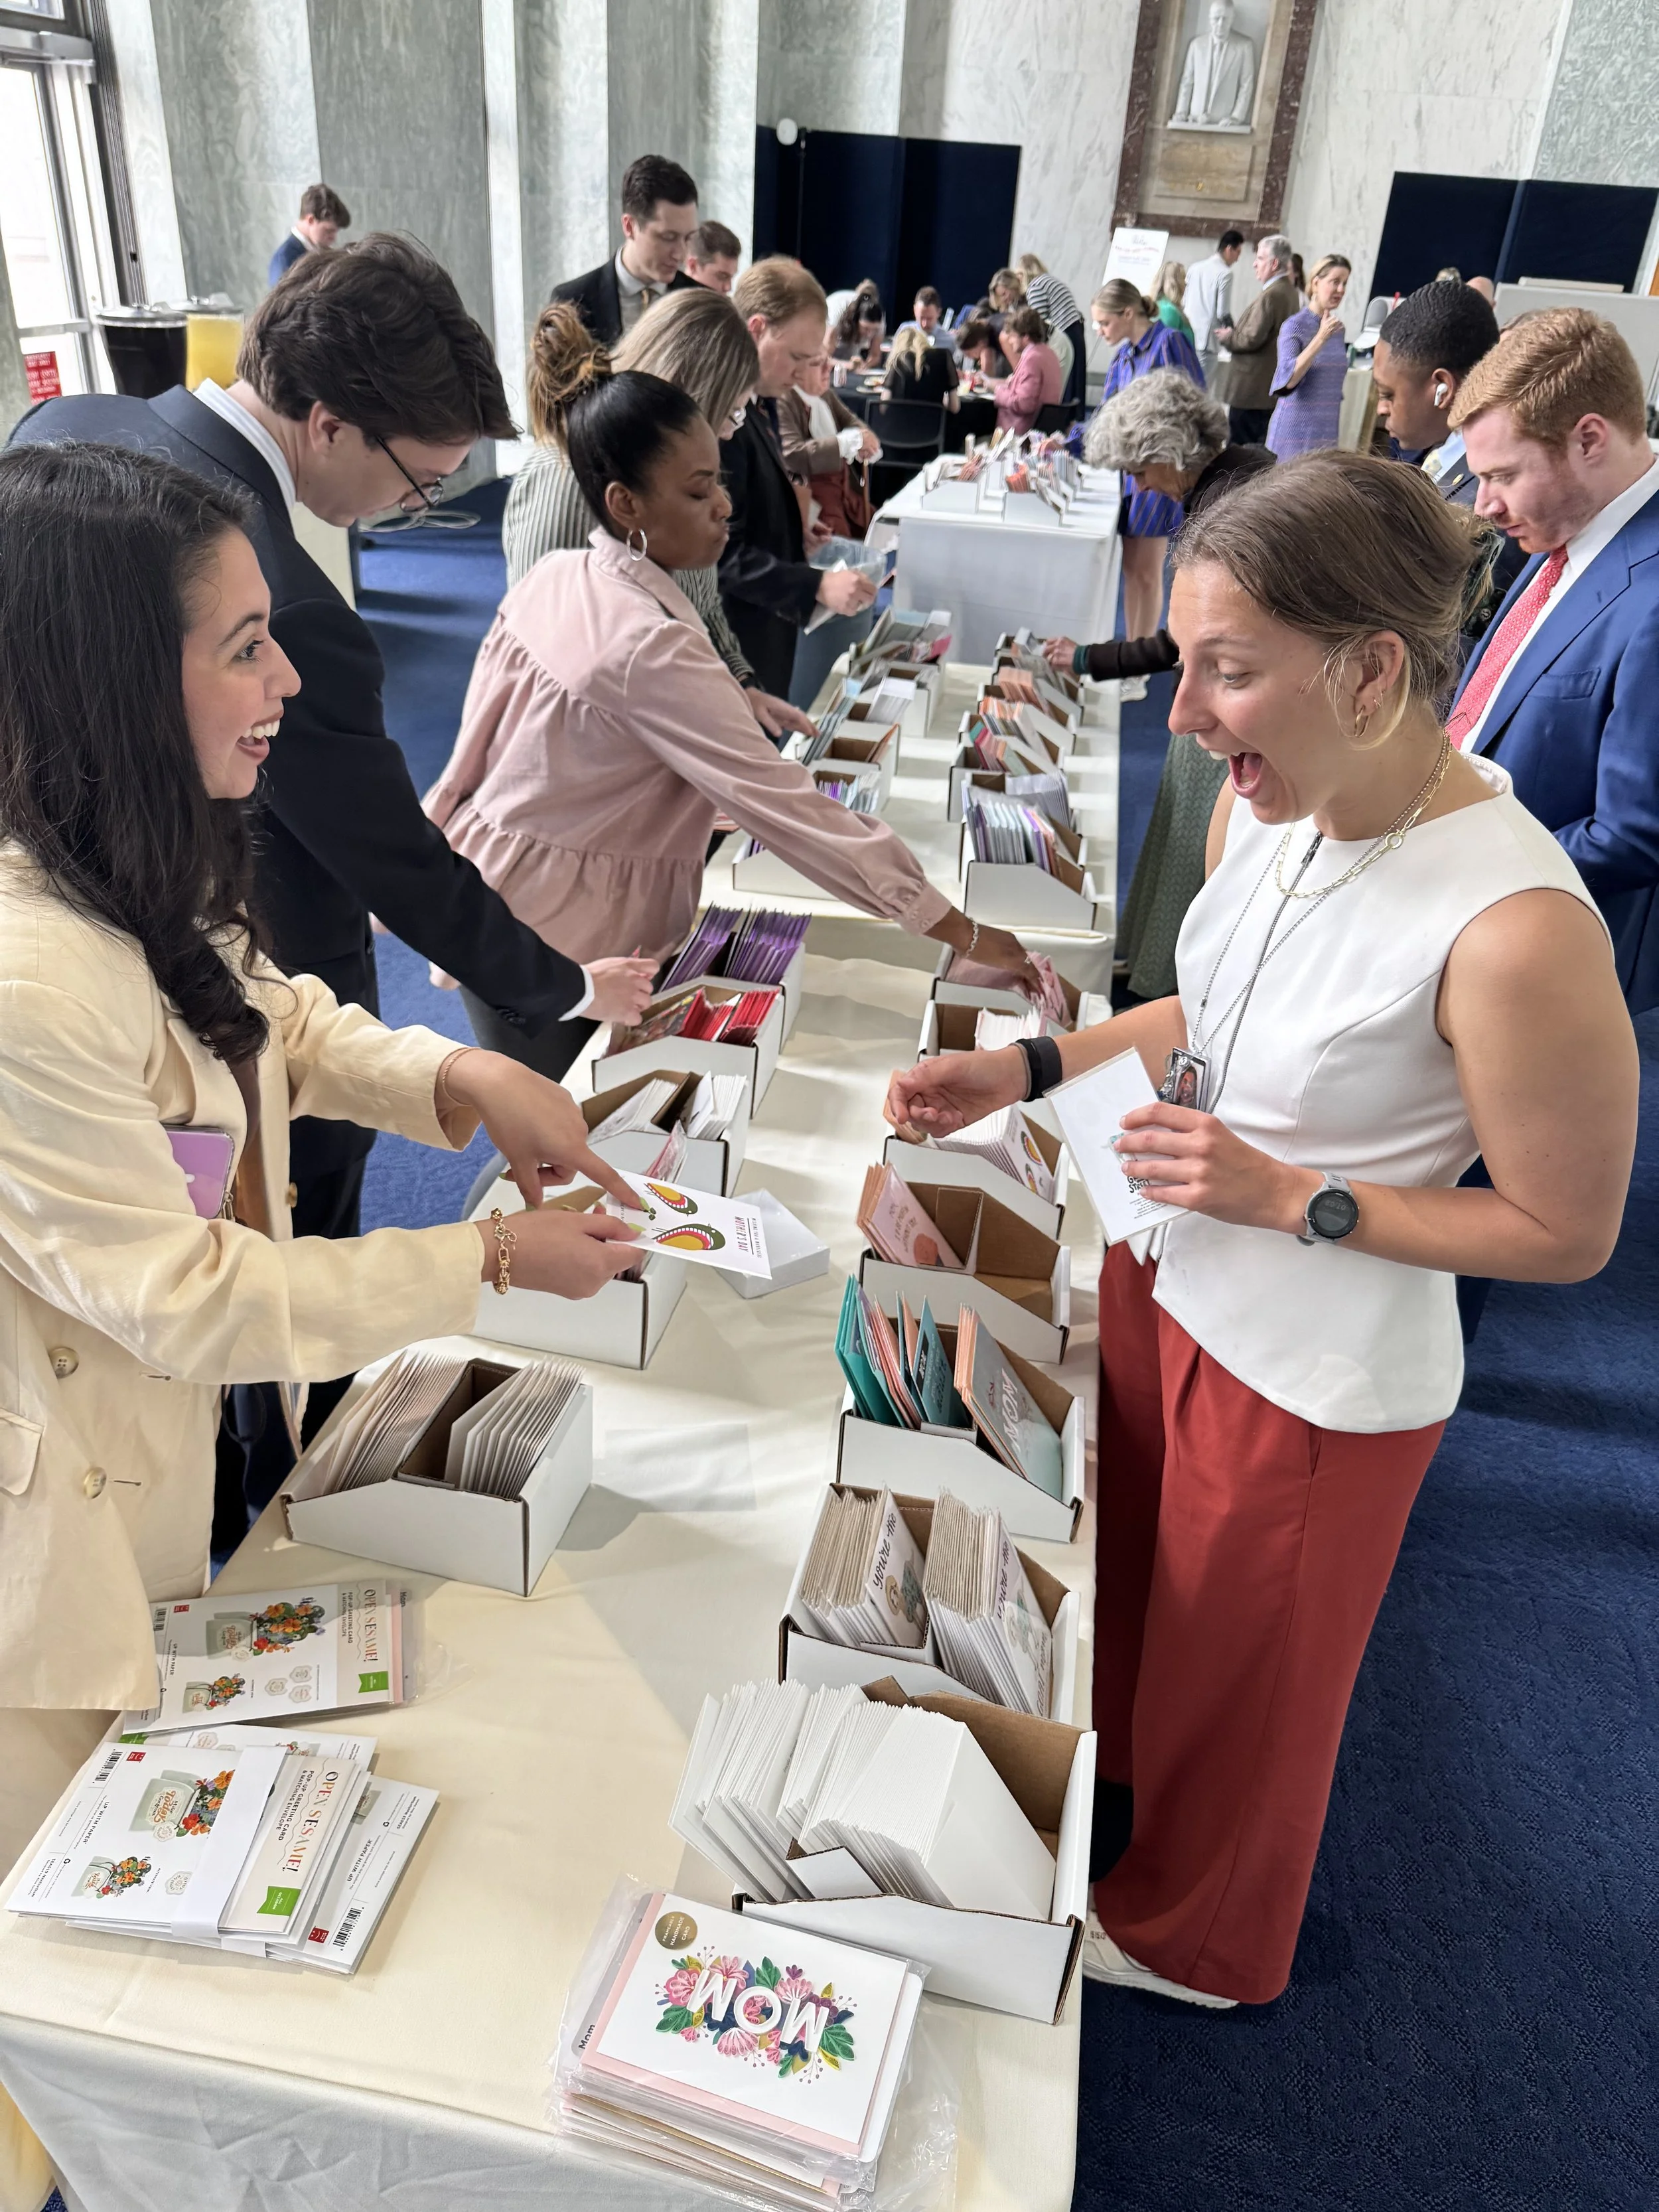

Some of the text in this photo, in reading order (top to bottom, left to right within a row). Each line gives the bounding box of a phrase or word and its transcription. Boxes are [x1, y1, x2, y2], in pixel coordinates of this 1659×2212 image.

[1129, 1179, 1150, 1193] STREET
[735, 1216, 749, 1252] MOTHER'S DAY
[887, 1512, 897, 1537] the
[364, 1589, 376, 1615] OPEN
[364, 1617, 378, 1662] SESAME!
[289, 1775, 305, 1801] MATCHING
[94, 1810, 105, 1824] WITH
[276, 1802, 292, 1830] ENVELOPE
[279, 1770, 314, 1840] POP-UP GREETING CARD
[283, 1771, 338, 1872] OPEN SESAME!
[352, 1858, 362, 1872] WITH
[360, 1839, 372, 1857] PAPER
[670, 1917, 685, 1945] HANDMADE
[579, 2023, 596, 2051] Mom
